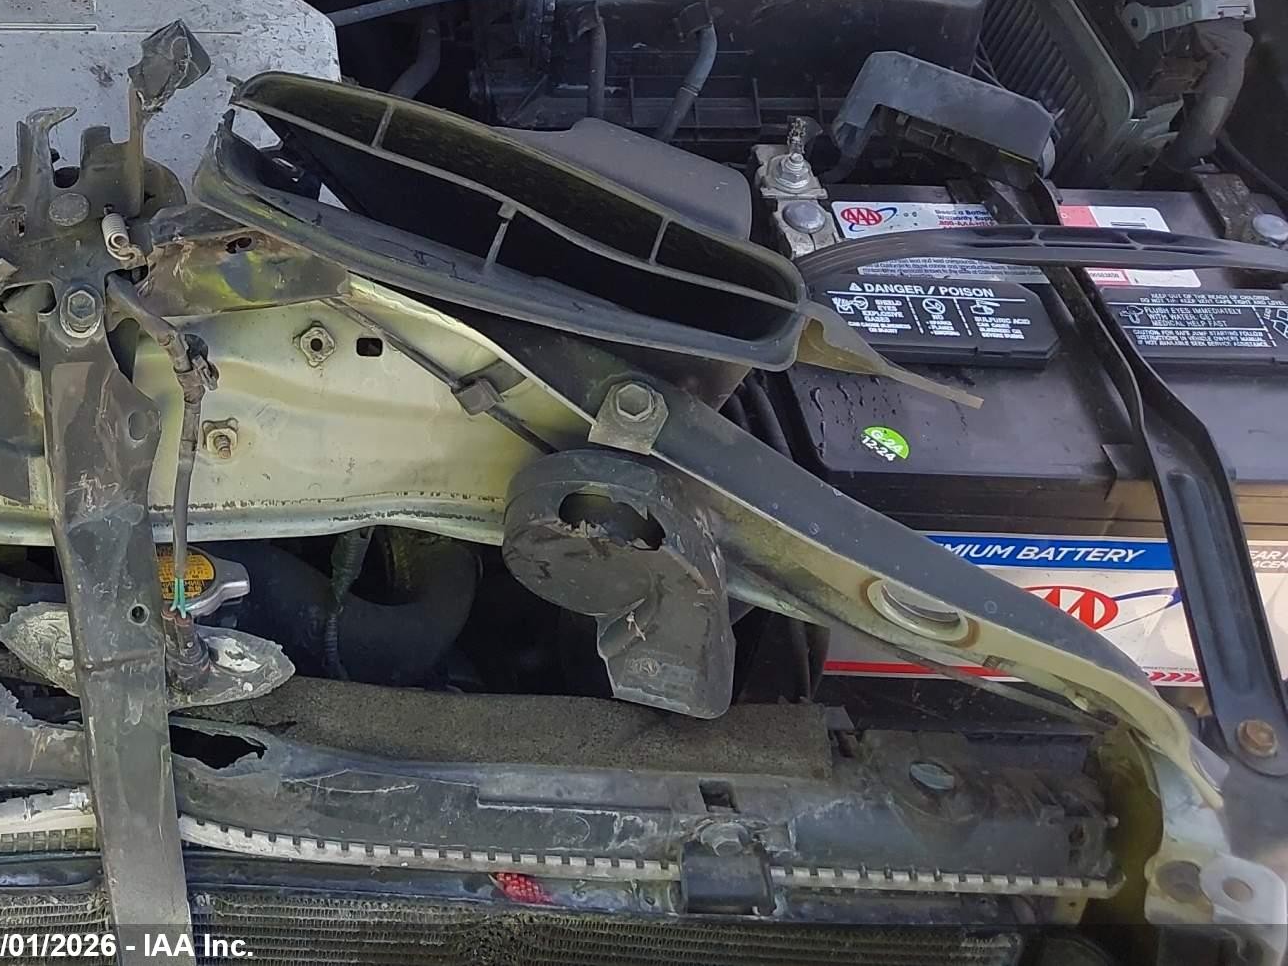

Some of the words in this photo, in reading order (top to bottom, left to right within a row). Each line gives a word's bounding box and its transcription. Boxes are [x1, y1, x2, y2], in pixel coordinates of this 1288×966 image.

[842, 207, 882, 225] AAA
[863, 283, 924, 295] DANGER
[927, 285, 937, 295] /
[938, 286, 995, 298] POISON
[1148, 313, 1168, 321] WITH
[1192, 307, 1243, 315] IMMEDIATELY
[861, 434, 897, 462] 12-24
[938, 544, 1016, 559] MIUM
[1016, 546, 1147, 563] BATTERY
[1249, 550, 1282, 560] EAR
